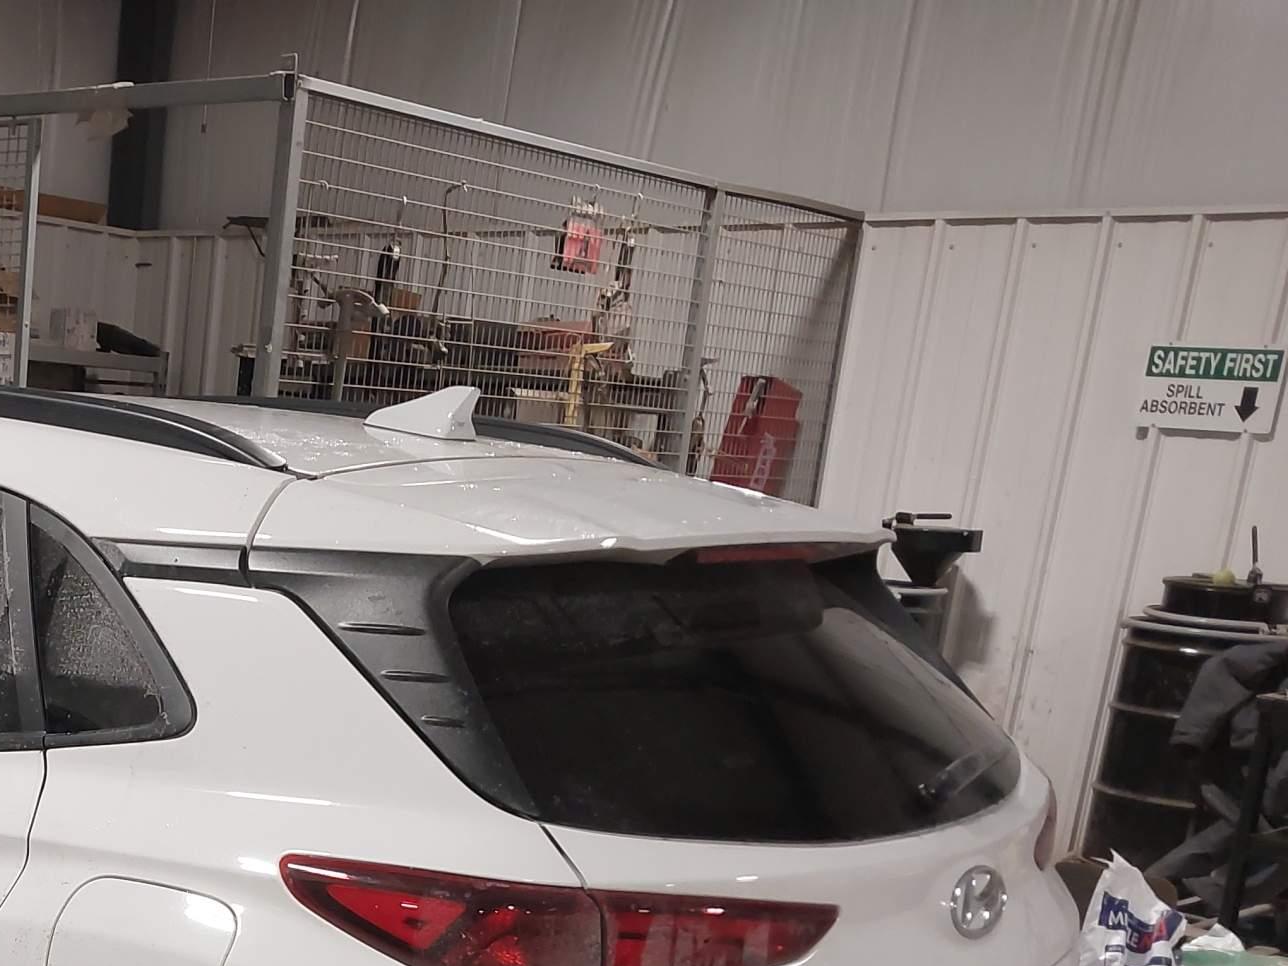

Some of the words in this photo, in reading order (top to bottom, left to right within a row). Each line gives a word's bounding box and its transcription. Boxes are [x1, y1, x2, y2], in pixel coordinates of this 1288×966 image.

[1151, 349, 1222, 376] SAFETY
[1223, 353, 1278, 378] FIRST
[1166, 383, 1203, 399] SPILL
[1139, 399, 1225, 416] ABSORBENT
